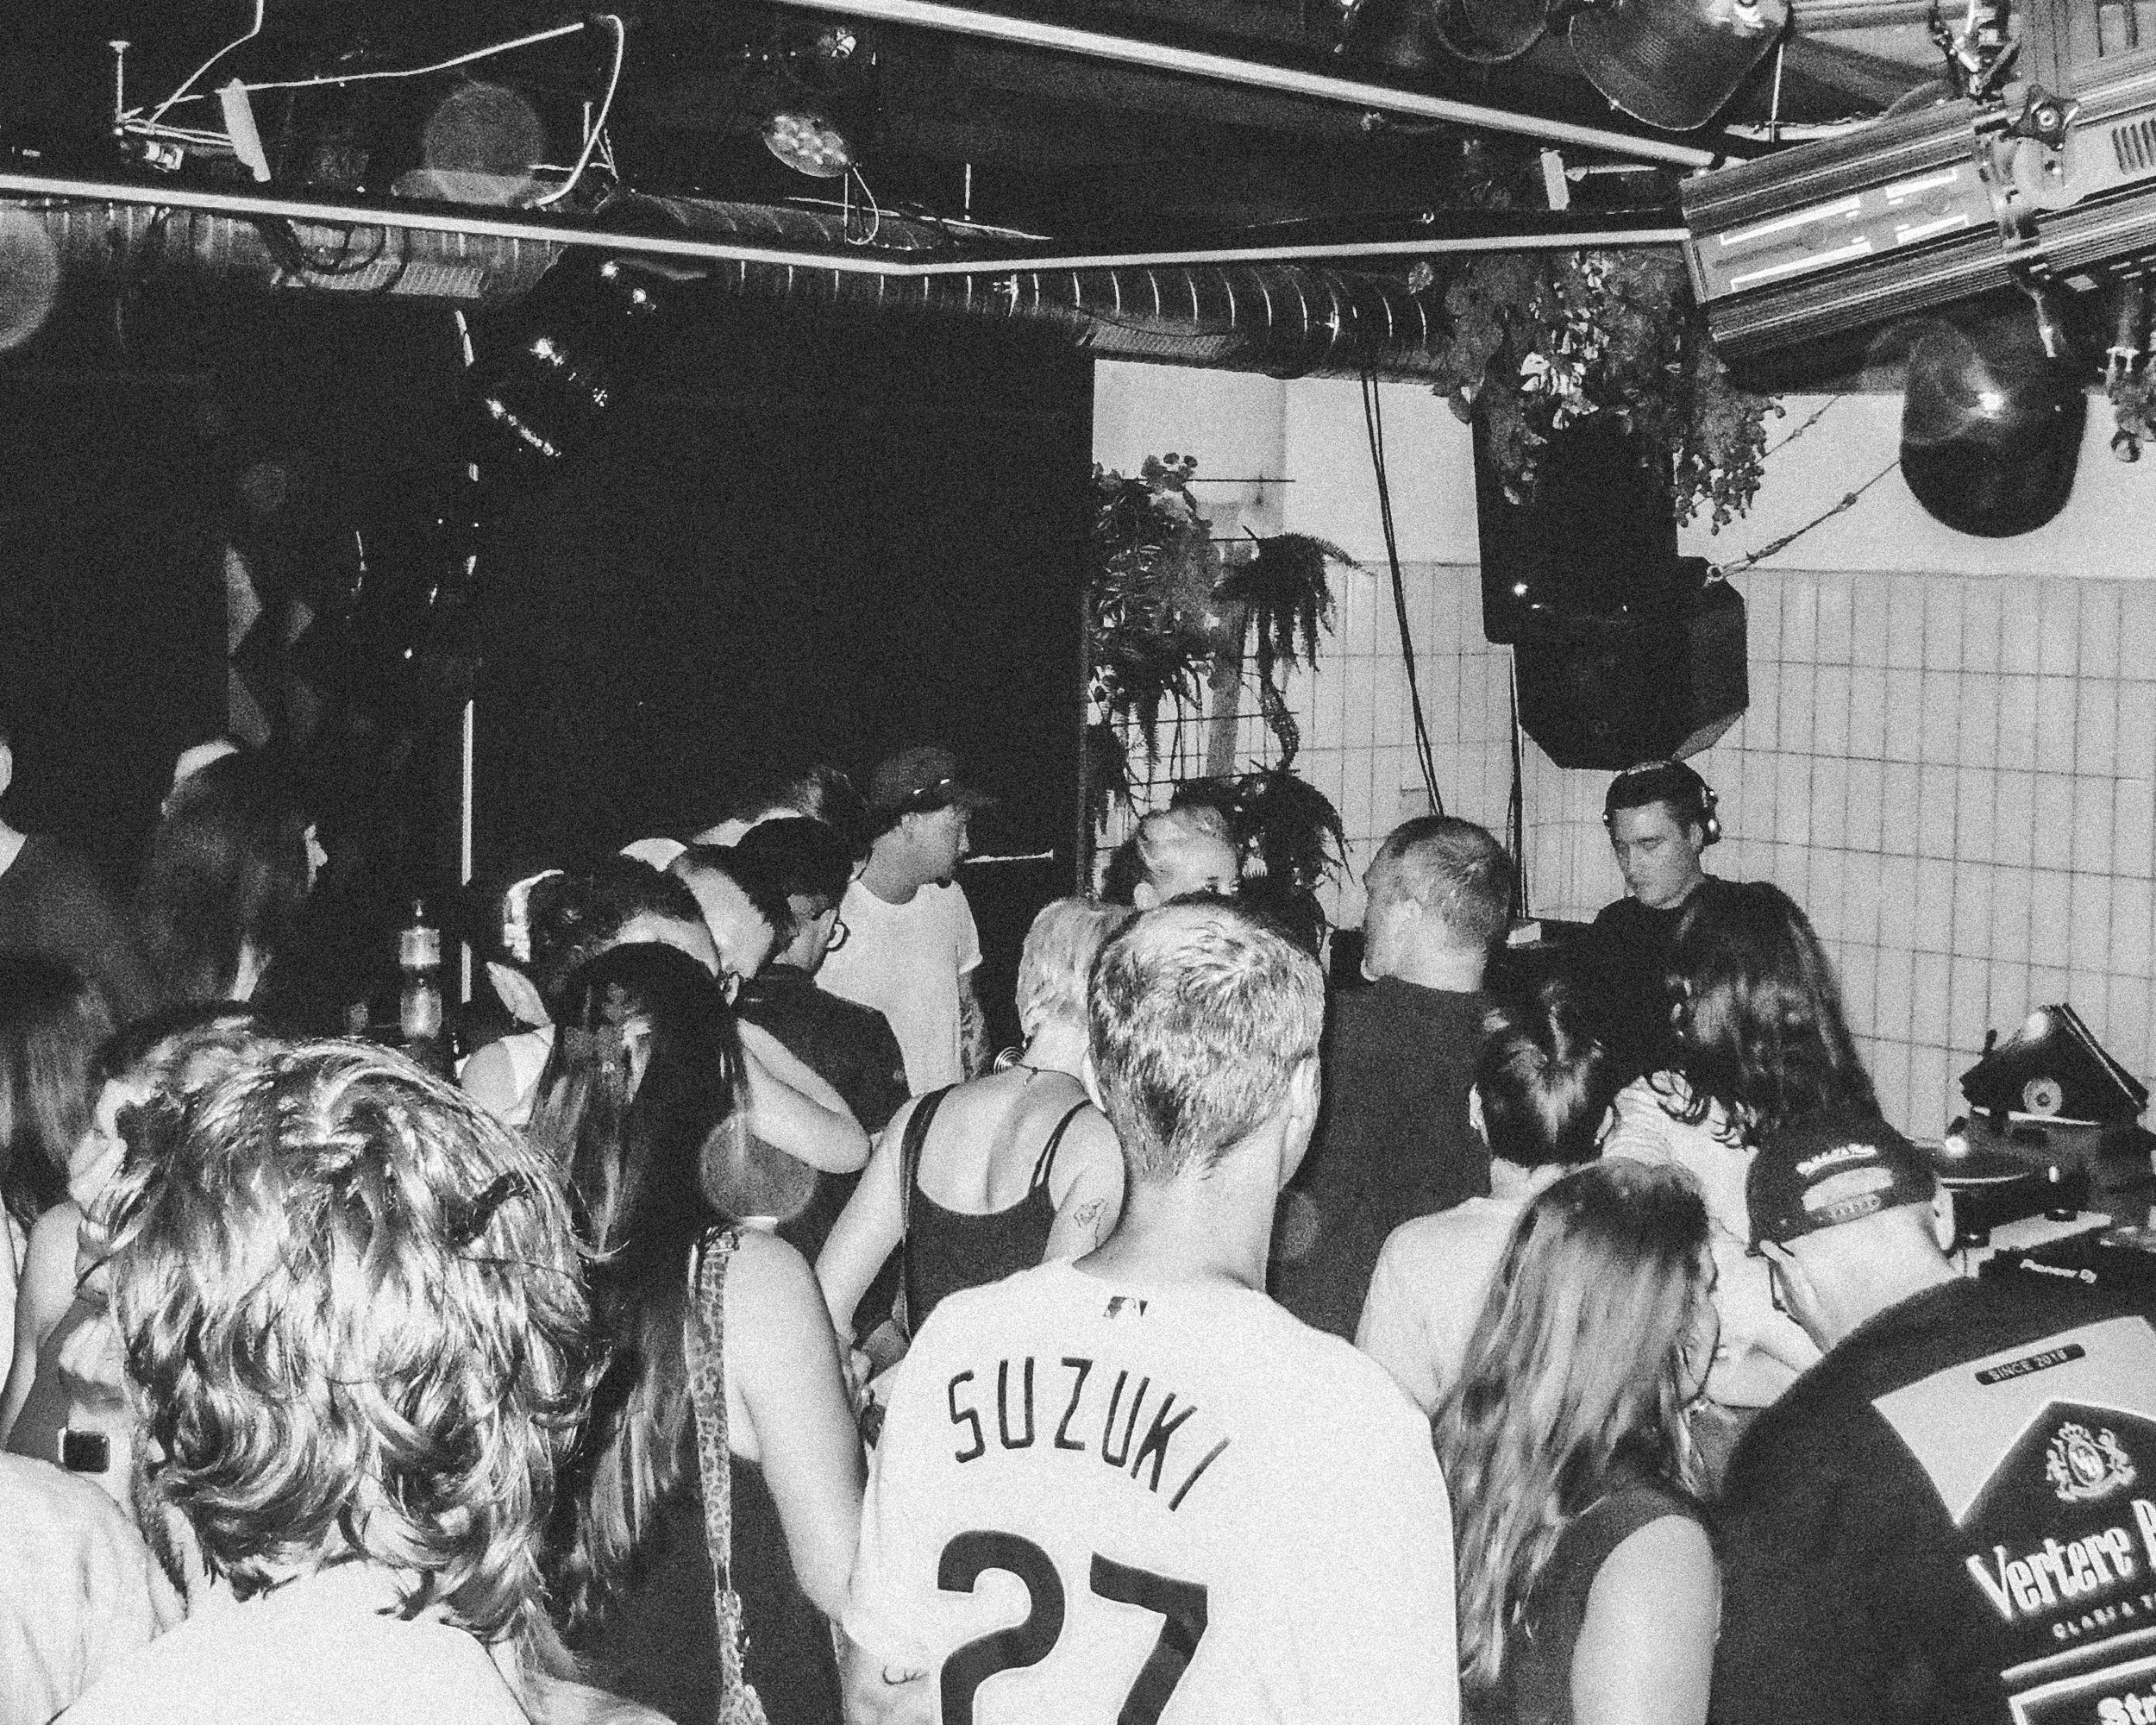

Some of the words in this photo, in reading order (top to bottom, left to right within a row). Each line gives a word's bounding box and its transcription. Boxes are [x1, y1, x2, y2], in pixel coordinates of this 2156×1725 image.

[1988, 1360, 2034, 1380] SINCE
[949, 1357, 1232, 1511] SUZUKI
[937, 1530, 1208, 1725] 27
[1966, 1527, 2134, 1622] Vertere
